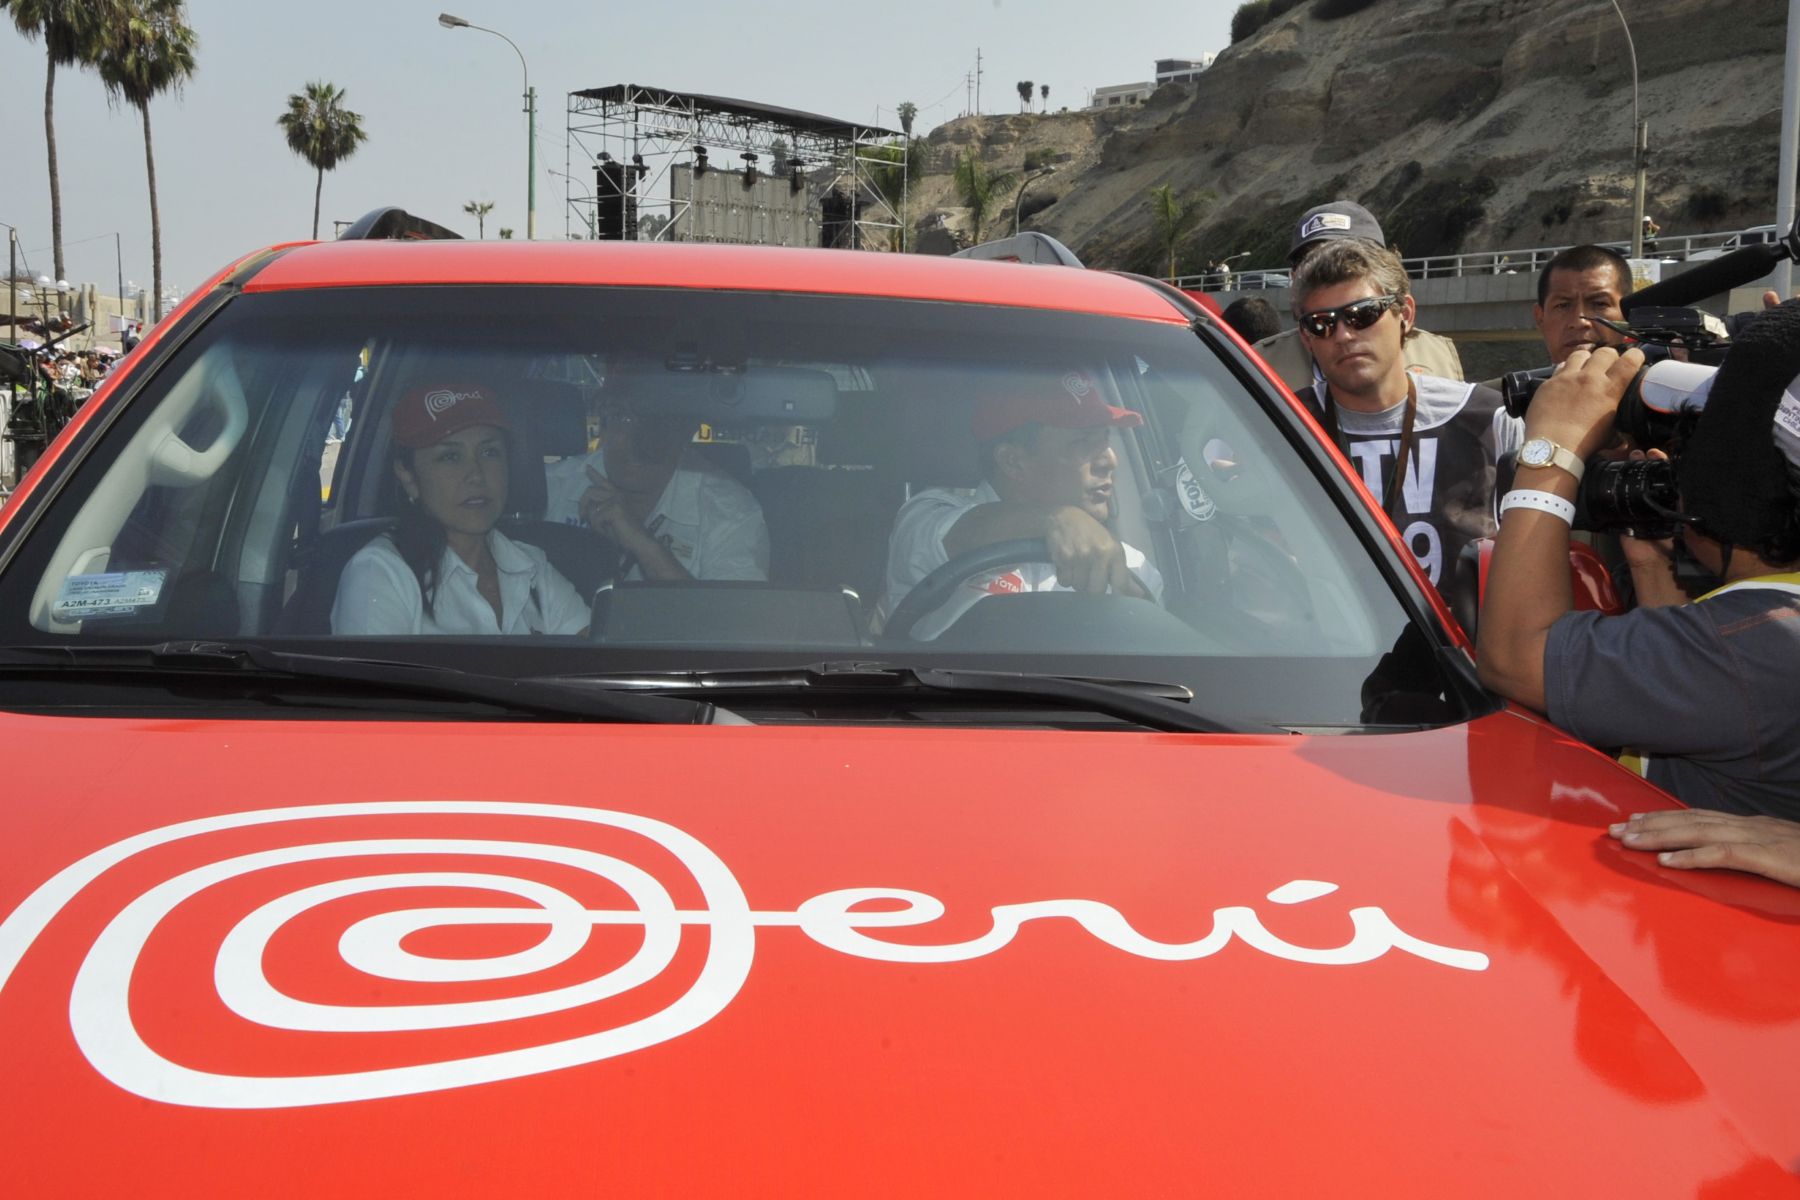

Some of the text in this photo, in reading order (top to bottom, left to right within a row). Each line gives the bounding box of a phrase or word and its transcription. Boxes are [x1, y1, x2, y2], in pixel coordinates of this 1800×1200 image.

[1350, 437, 1438, 514] TV
[1181, 479, 1205, 511] FOX
[61, 598, 111, 608] A2M-473
